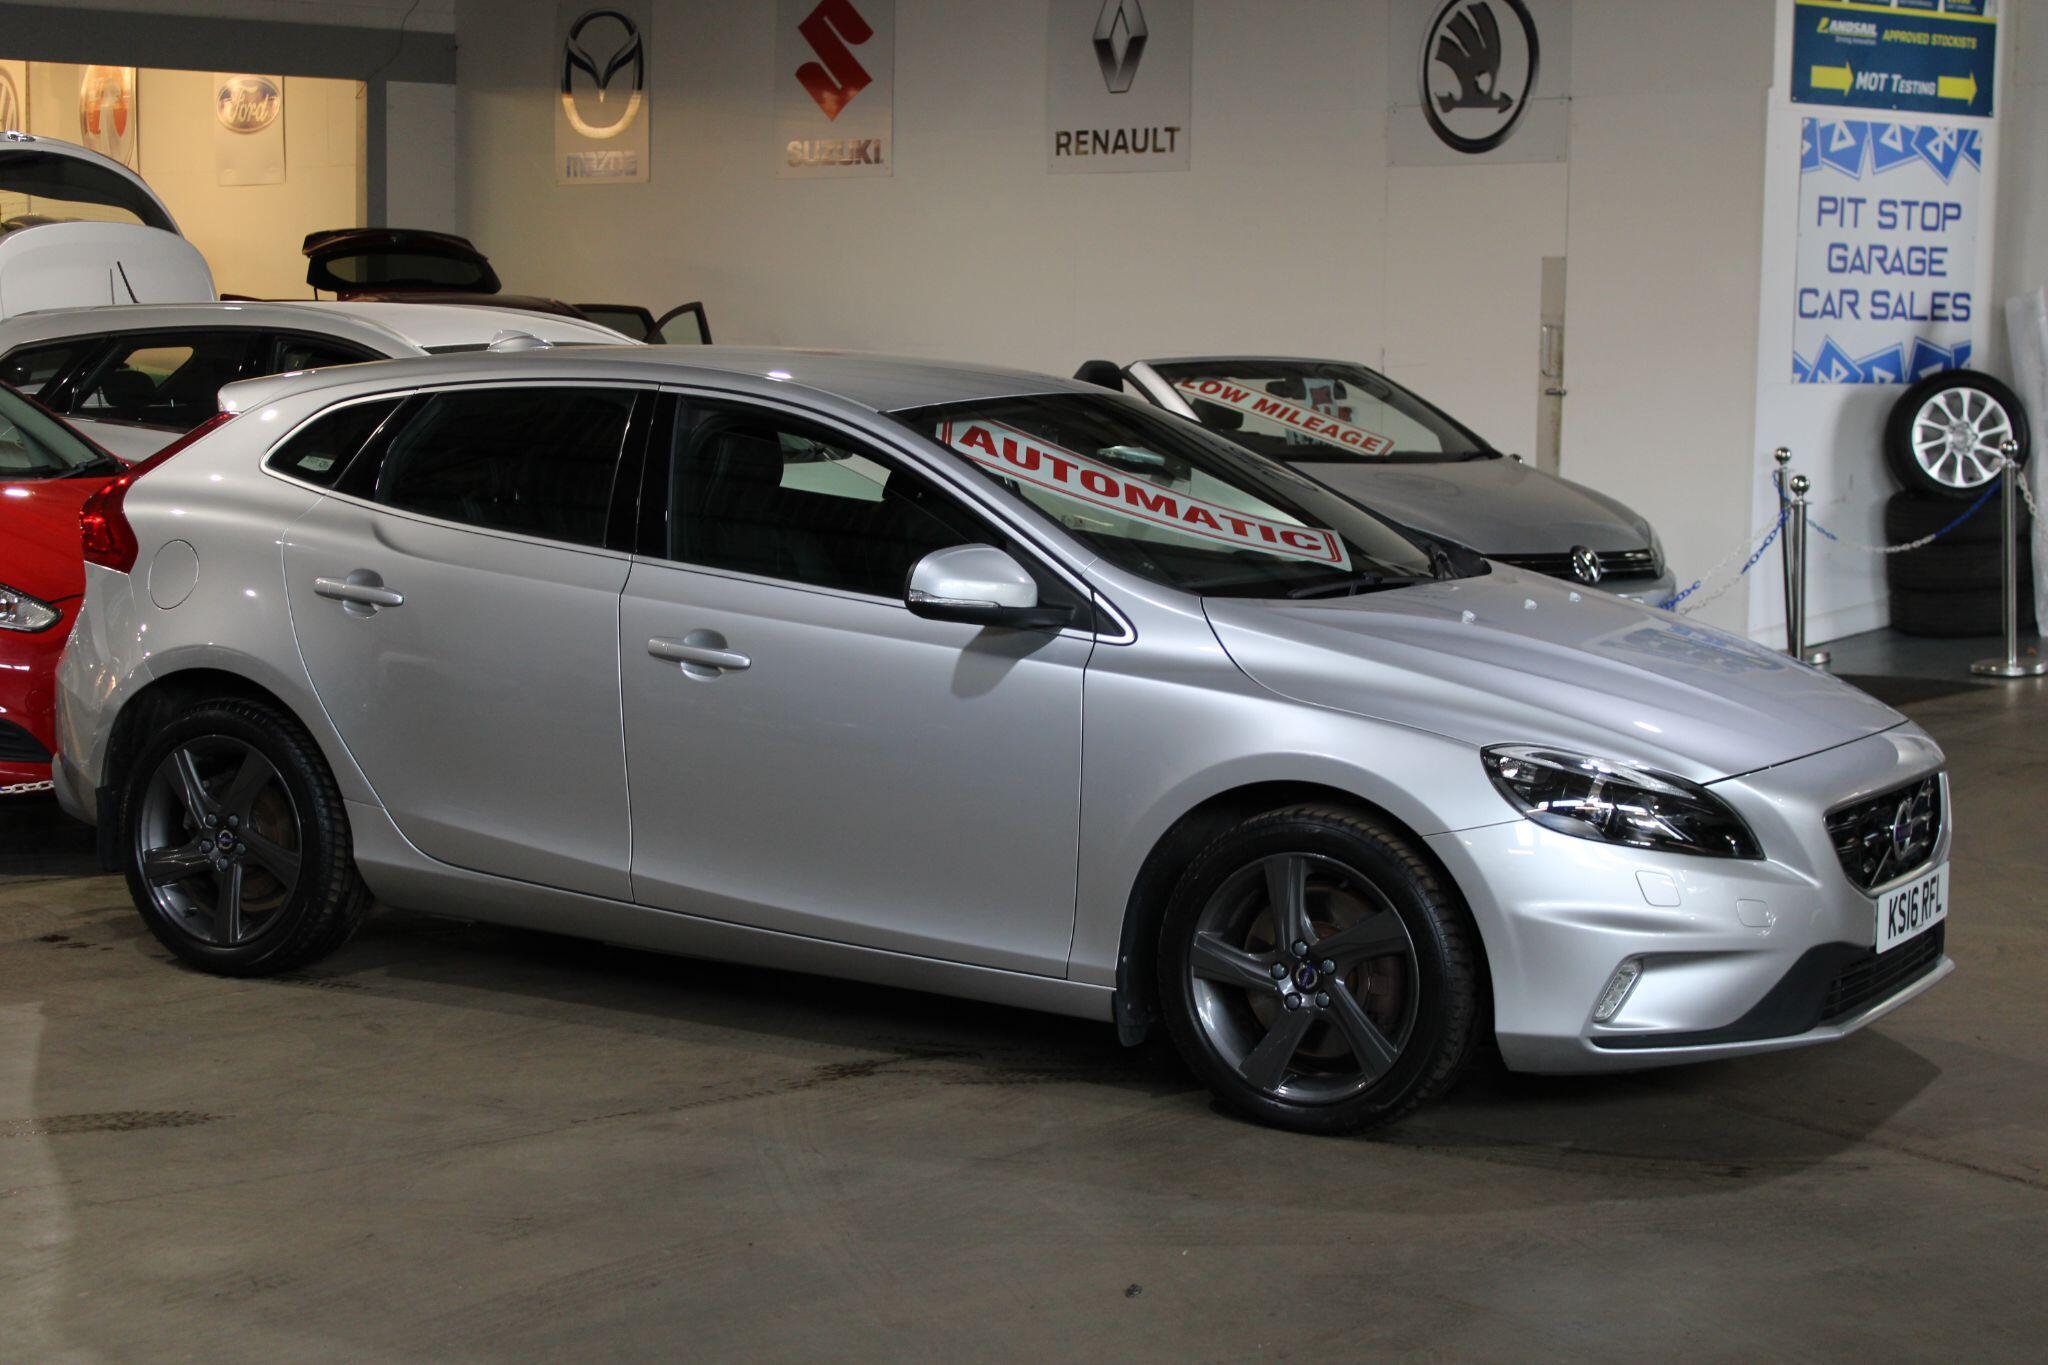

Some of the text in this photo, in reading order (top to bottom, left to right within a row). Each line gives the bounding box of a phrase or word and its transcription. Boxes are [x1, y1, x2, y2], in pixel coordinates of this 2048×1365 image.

[1855, 71, 1890, 92] MOT
[222, 86, 270, 123] Ford
[787, 139, 882, 167] SUZUKI
[1055, 127, 1181, 156] RENAULT
[1817, 196, 1962, 232] PIT STOP
[1827, 243, 1948, 277] GARAGE
[1799, 288, 1971, 322] CAR SALES
[1180, 378, 1250, 403] LOW
[1251, 397, 1382, 453] MILEAGE
[959, 425, 1322, 551] AUTOMATIC
[1888, 873, 1942, 940] KS16 RFL
